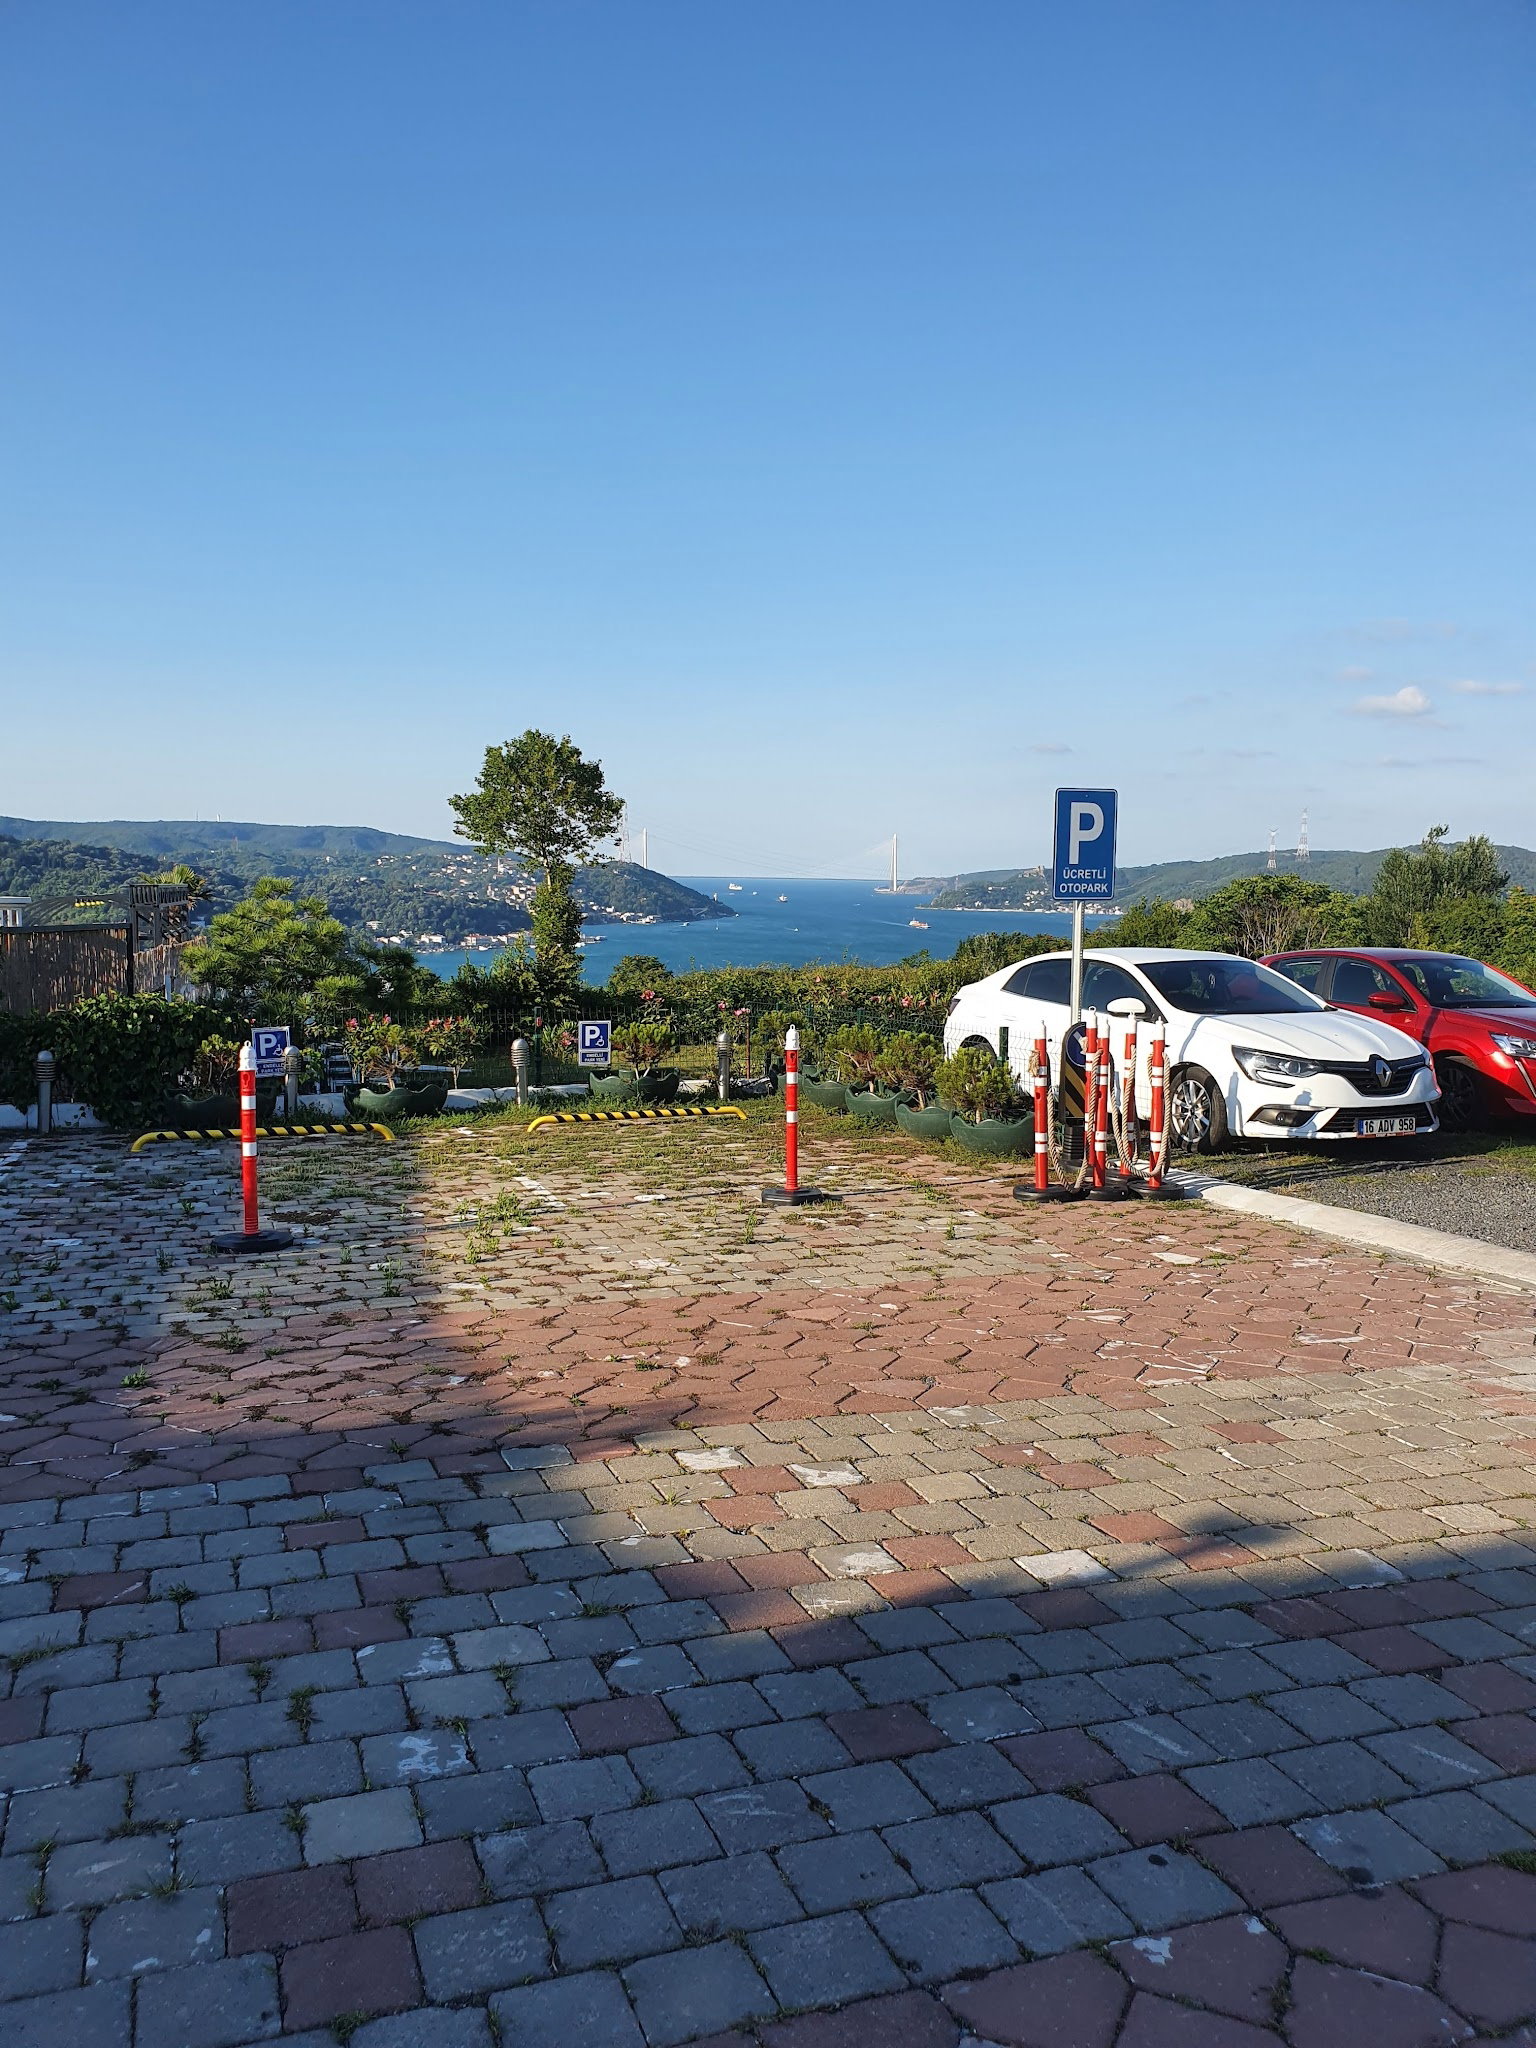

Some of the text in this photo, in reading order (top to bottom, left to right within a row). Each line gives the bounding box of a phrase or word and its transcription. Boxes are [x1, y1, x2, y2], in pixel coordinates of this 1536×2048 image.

[1069, 802, 1104, 865] P
[1063, 867, 1106, 879] ÜCRETLİ
[1060, 883, 1108, 893] OTOPARK
[260, 1034, 277, 1057] P
[585, 1026, 600, 1047] P
[1365, 1121, 1374, 1133] 16
[1378, 1119, 1395, 1132] ADV
[1399, 1118, 1414, 1131] 958
